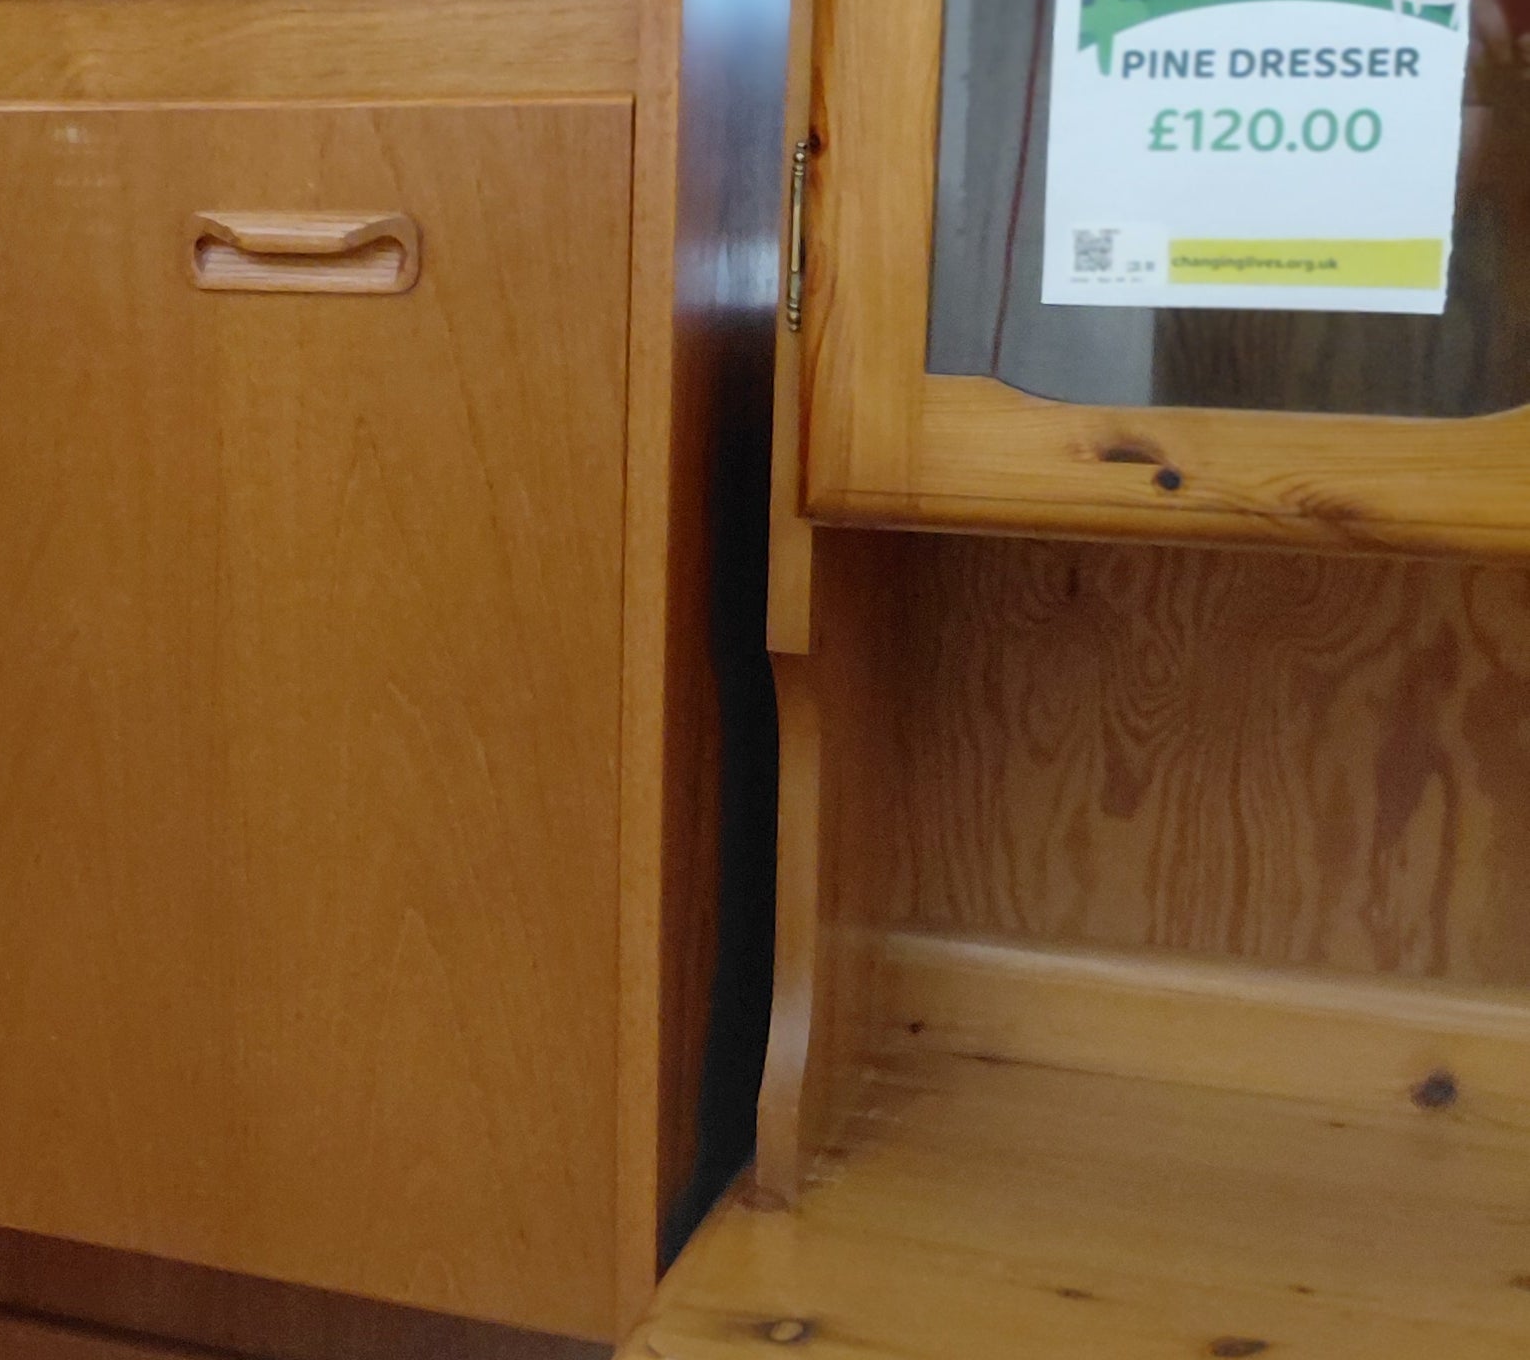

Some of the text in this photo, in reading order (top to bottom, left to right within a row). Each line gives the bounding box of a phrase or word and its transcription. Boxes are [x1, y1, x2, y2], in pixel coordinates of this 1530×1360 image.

[1120, 46, 1420, 80] PINE DRESSER
[1146, 107, 1384, 153] £120.00
[1171, 254, 1338, 274] changinglives.org.uk
